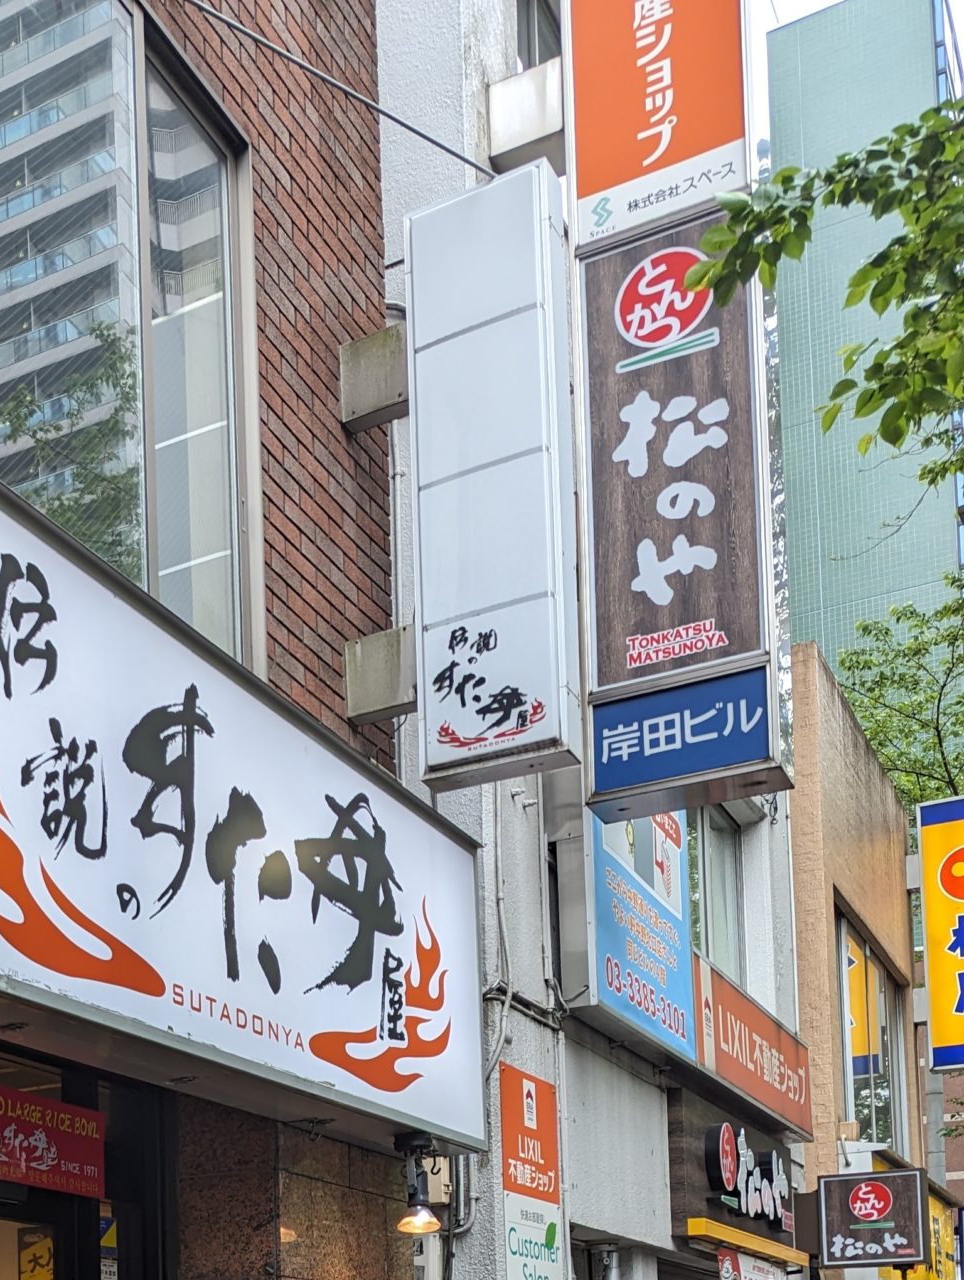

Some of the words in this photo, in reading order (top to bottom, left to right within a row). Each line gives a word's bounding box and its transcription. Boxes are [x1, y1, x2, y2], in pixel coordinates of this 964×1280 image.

[627, 161, 736, 213] 株式会社スペース
[612, 390, 730, 606] 松のや
[628, 620, 715, 650] TONKATSU
[628, 632, 728, 668] MATSUNOYA
[601, 698, 764, 764] 岸田ビル
[605, 953, 687, 1041] 03-3385-3101
[172, 981, 306, 1053] SUTADONYA
[7, 1100, 43, 1124] LARGE
[45, 1110, 73, 1133] RICE
[74, 1116, 101, 1139] BOWL
[518, 1134, 544, 1164] LIXIL
[61, 1160, 80, 1174] SINCE
[84, 1163, 98, 1178] 1971
[508, 1158, 555, 1193] 不動産ショップ
[853, 1183, 885, 1220] とんかつ
[508, 1226, 560, 1264] Customer
[830, 1232, 908, 1258] 松のや
